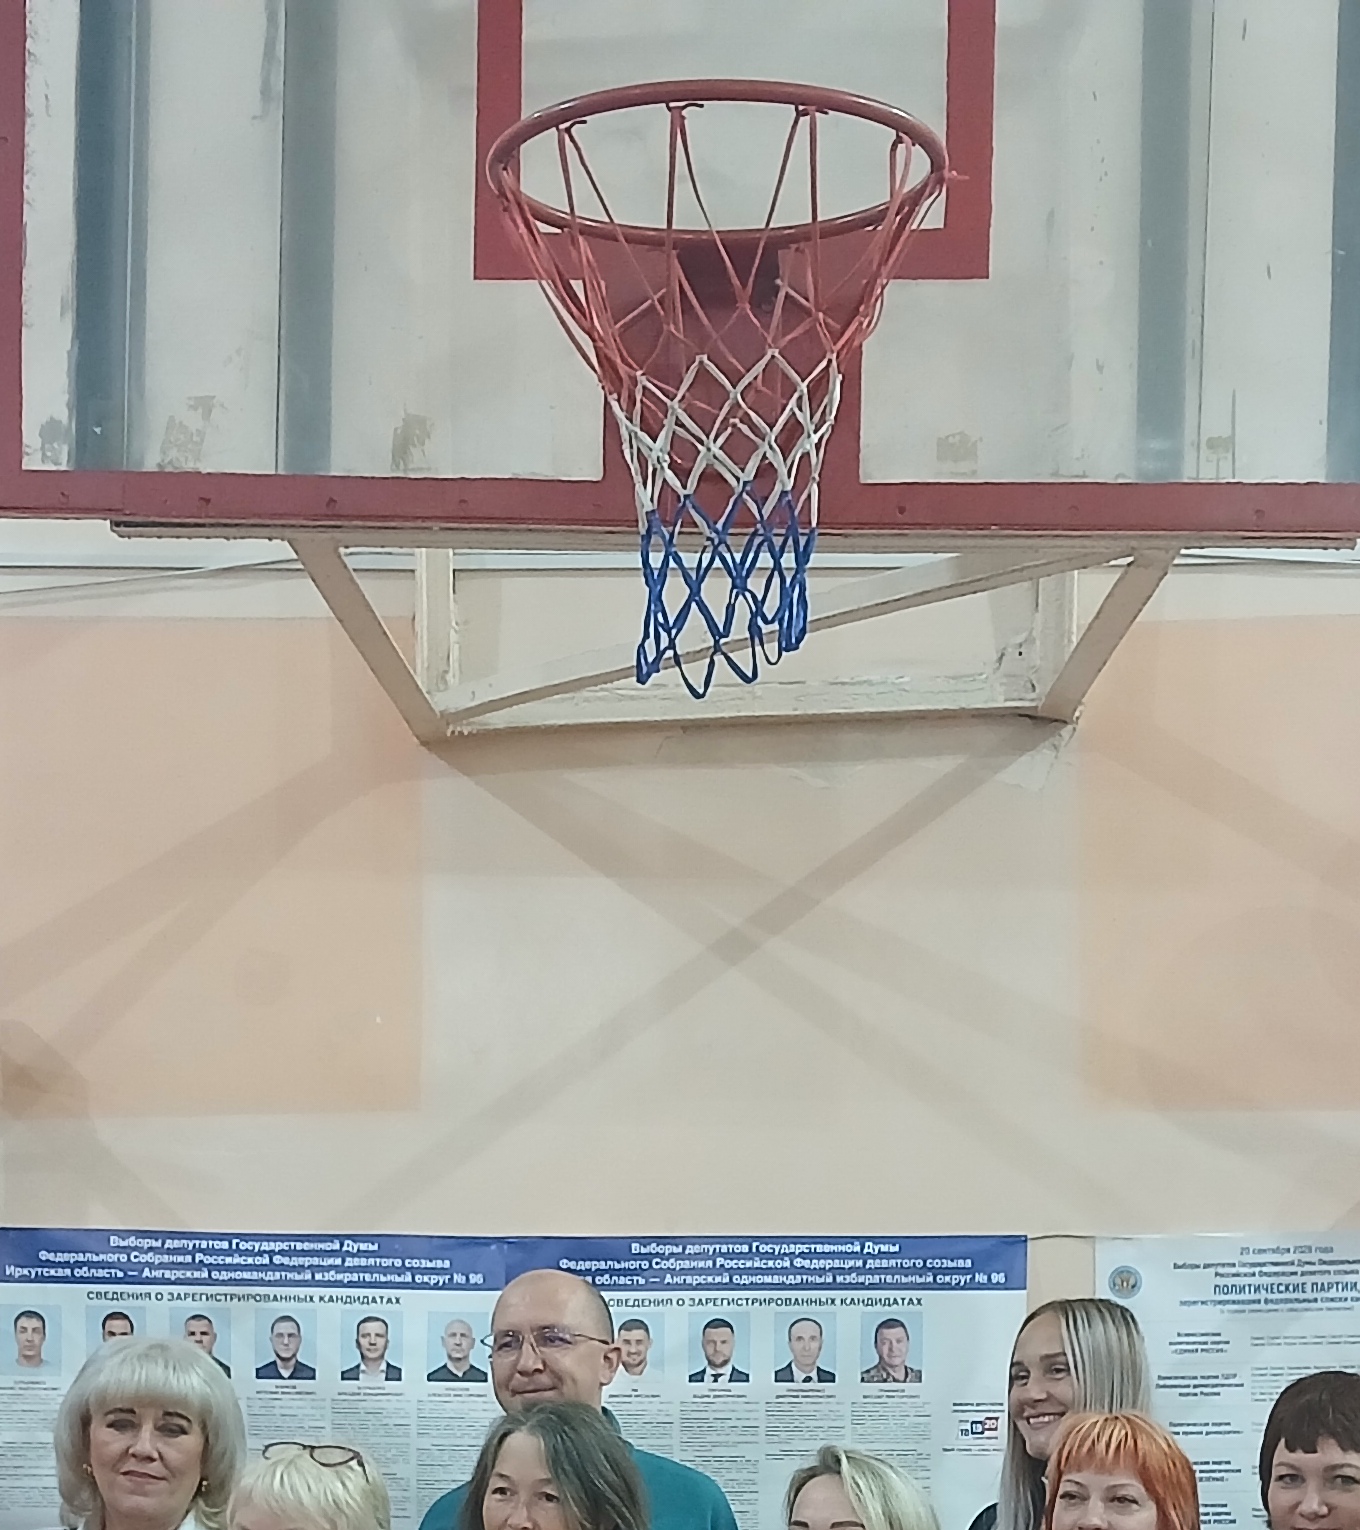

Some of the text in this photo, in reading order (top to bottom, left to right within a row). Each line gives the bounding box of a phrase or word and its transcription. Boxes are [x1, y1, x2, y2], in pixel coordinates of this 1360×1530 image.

[110, 1236, 379, 1253] Выборы депутатов Государственной Думы
[631, 1241, 900, 1256] Выборы депутатов Государственной Думы
[39, 1250, 451, 1268] Федерального Собрания Российской Федерации девятого созыва
[559, 1257, 972, 1271] Федерального Собрания Российской Федерации девятого созыва
[5, 1264, 72, 1279] Иркутская
[74, 1266, 124, 1278] область
[142, 1267, 209, 1281] Ангарский
[211, 1268, 312, 1283] одномандатный
[314, 1269, 412, 1284] избирательный
[415, 1273, 452, 1286] округ
[453, 1273, 467, 1284] №
[595, 1273, 646, 1285] область
[664, 1272, 730, 1286] Ангарский
[732, 1273, 833, 1286] одномандатный
[836, 1272, 933, 1286] избирательный
[936, 1274, 973, 1286] округ
[974, 1272, 988, 1283] №
[1213, 1281, 1360, 1296] ПОЛИТИЧЕСКИЕ ПАРТИИ,
[86, 1290, 402, 1306] СВЕДЕНИЯ О ЗАРЕГИСТРИРОВАННЫХ КАНДИДАТАХ
[676, 1297, 686, 1308] О
[688, 1297, 836, 1308] ЗАРЕГИСТРИРОВАННЫХ
[840, 1297, 923, 1308] КАНДИДАТАХ
